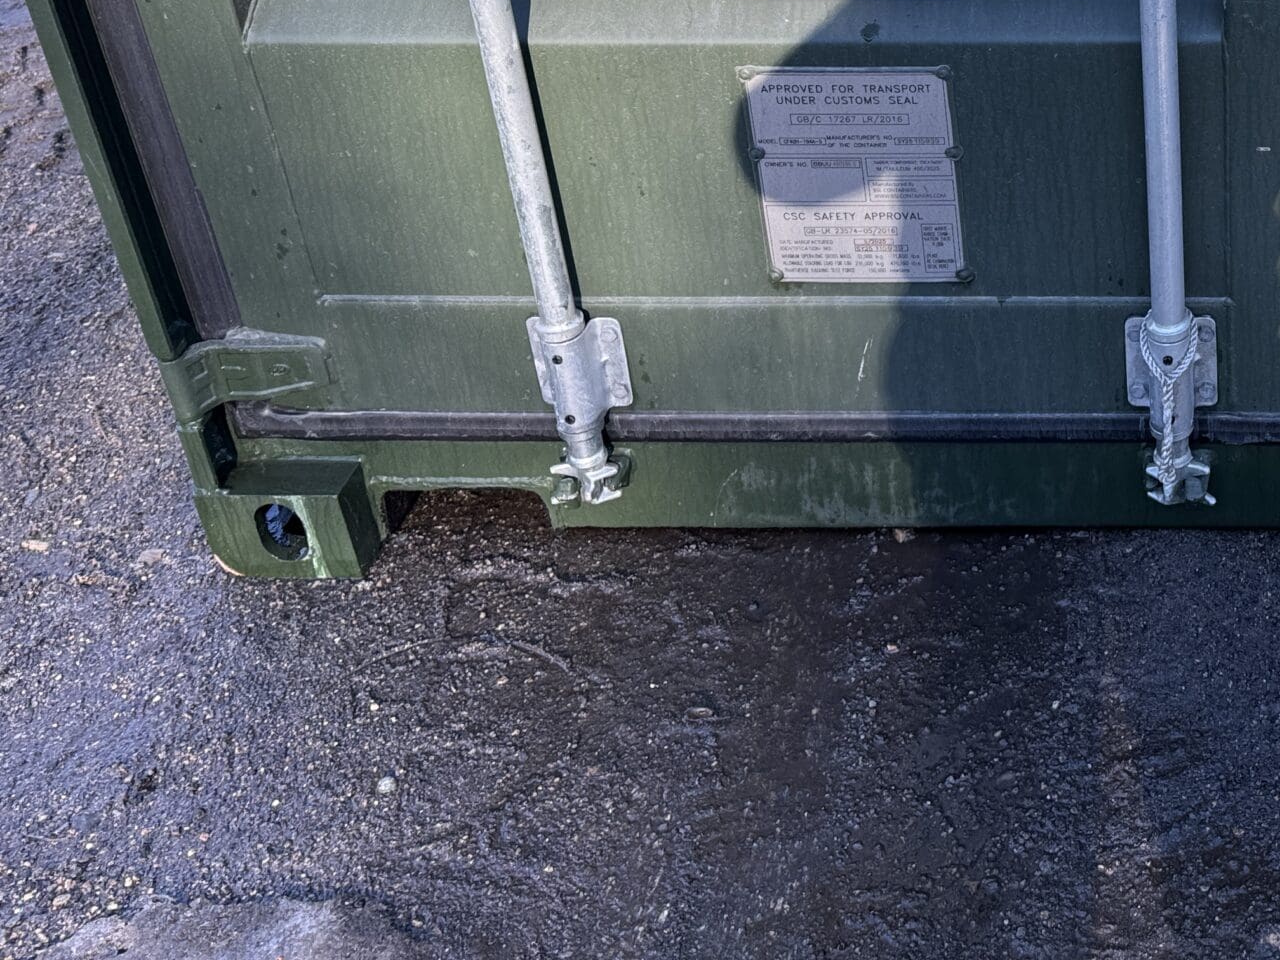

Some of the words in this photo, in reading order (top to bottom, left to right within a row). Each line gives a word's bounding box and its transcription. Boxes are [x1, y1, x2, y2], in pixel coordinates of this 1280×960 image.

[760, 84, 823, 94] APPROVED
[831, 84, 854, 94] FOR
[862, 84, 931, 94] TRANSPORT
[776, 96, 816, 105] UNDER
[824, 96, 880, 105] CUSTOMS
[888, 96, 919, 105] SEAL
[784, 212, 806, 221] CSC
[814, 212, 855, 221] SAFETY
[864, 212, 923, 221] APPROVAL
